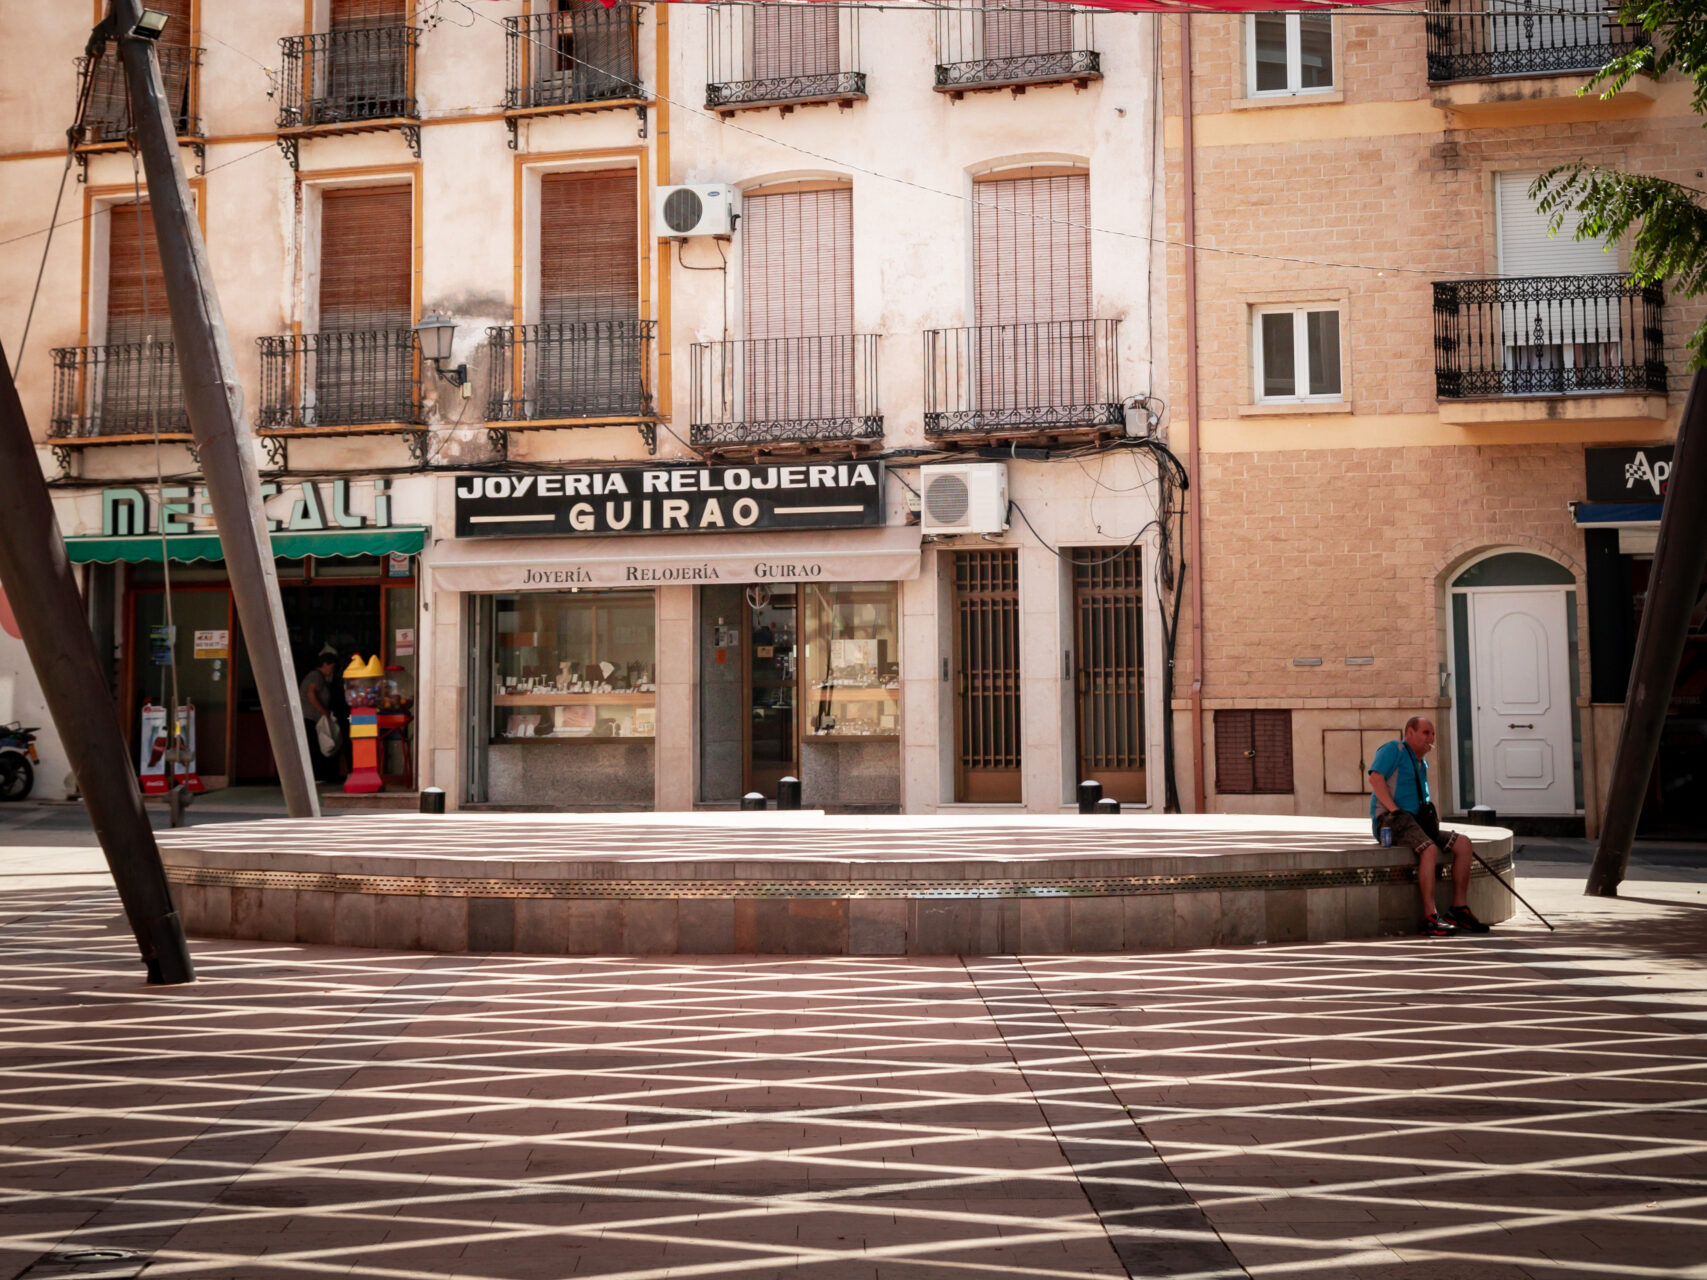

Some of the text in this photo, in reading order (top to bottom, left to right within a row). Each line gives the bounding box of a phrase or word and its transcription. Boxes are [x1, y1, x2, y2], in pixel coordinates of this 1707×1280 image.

[457, 463, 877, 499] JOYERIA RELOJERIA
[1625, 451, 1673, 495] Ap
[568, 496, 760, 531] GUIRAO
[1096, 525, 1102, 534] 2
[754, 562, 822, 578] GUIRAO
